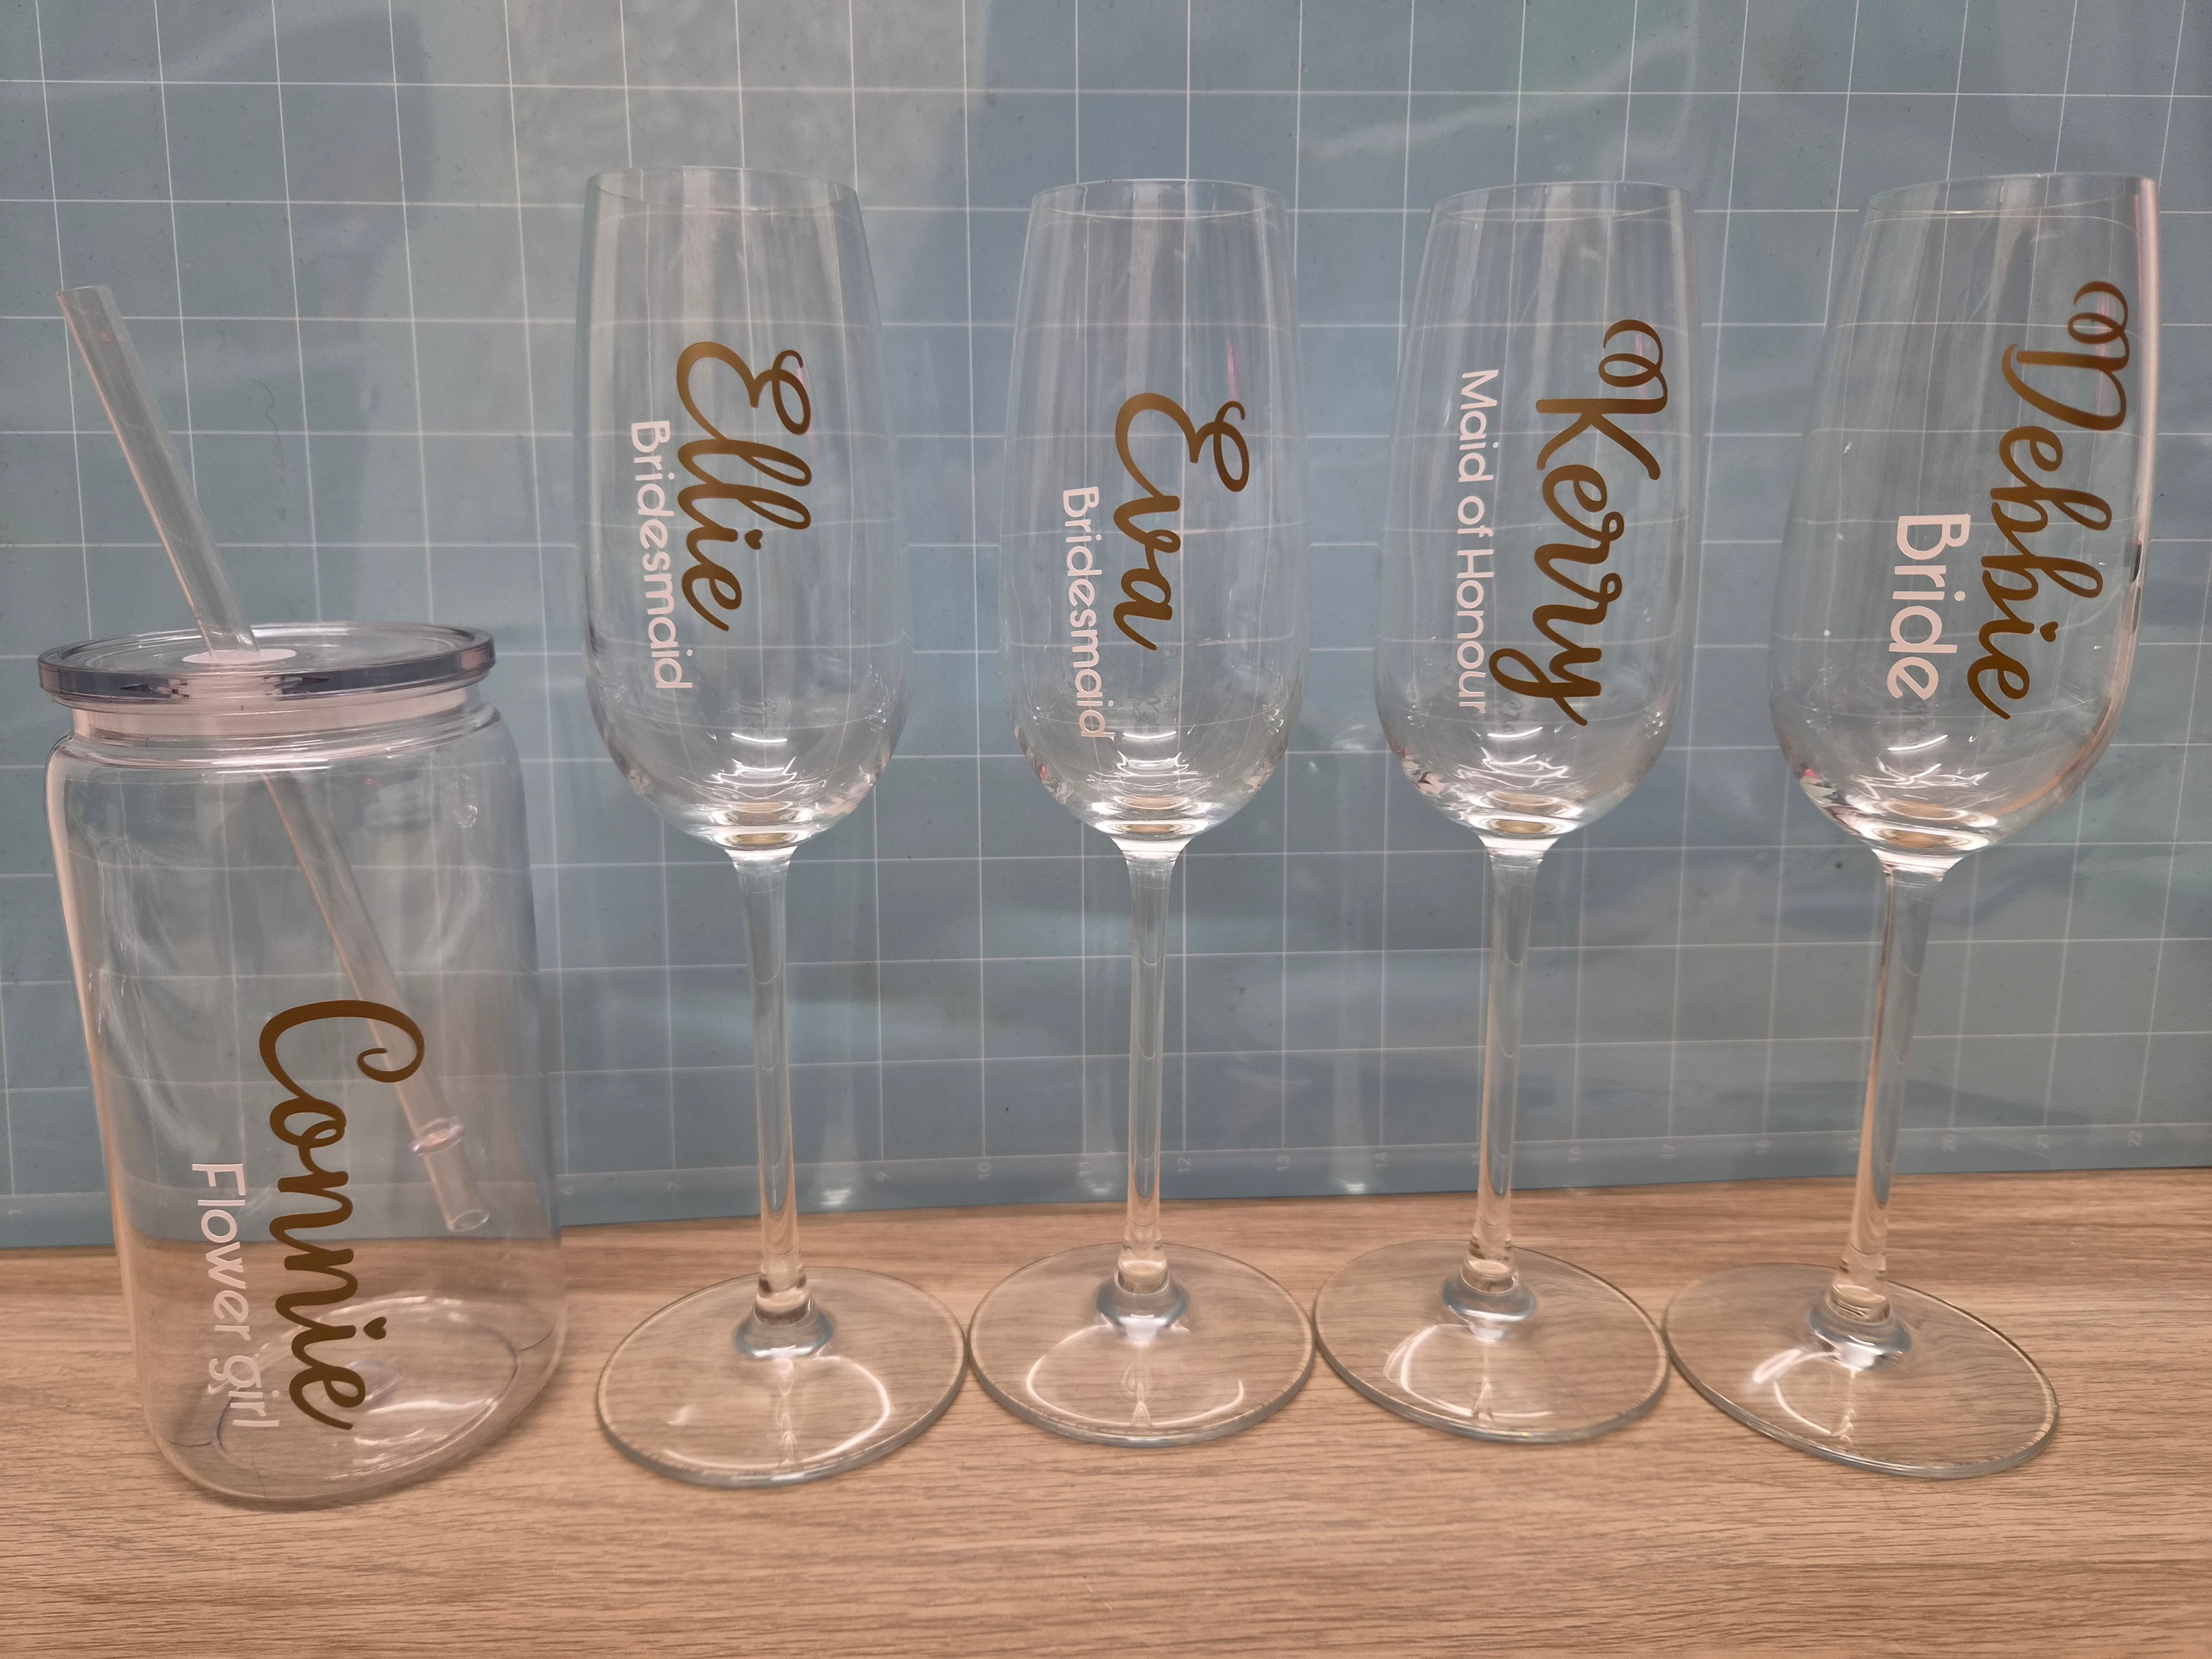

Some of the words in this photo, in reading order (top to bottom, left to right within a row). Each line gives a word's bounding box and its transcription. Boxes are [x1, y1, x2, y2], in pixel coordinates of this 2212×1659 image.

[676, 341, 811, 631] Ellie
[1459, 369, 1499, 483] Maid
[631, 420, 693, 688] Bridesmaid
[1113, 392, 1249, 650] Eva
[1457, 495, 1494, 538] of
[1489, 319, 1668, 726] Kerry
[1967, 281, 2130, 720] Debbie
[1063, 486, 1115, 738] Bridesmaid
[1456, 549, 1494, 714] Honour
[1887, 514, 1971, 700] Bride
[876, 1172, 889, 1180] 9
[978, 1162, 991, 1179] 10
[1078, 1161, 1091, 1177] 11
[1177, 1157, 1190, 1173] 12
[1277, 1154, 1290, 1171] 13
[1374, 1152, 1387, 1169] 14
[2128, 1130, 2141, 1147] 22
[192, 1163, 251, 1340] Flower
[259, 999, 425, 1430] Connie
[209, 1355, 280, 1427] girl
